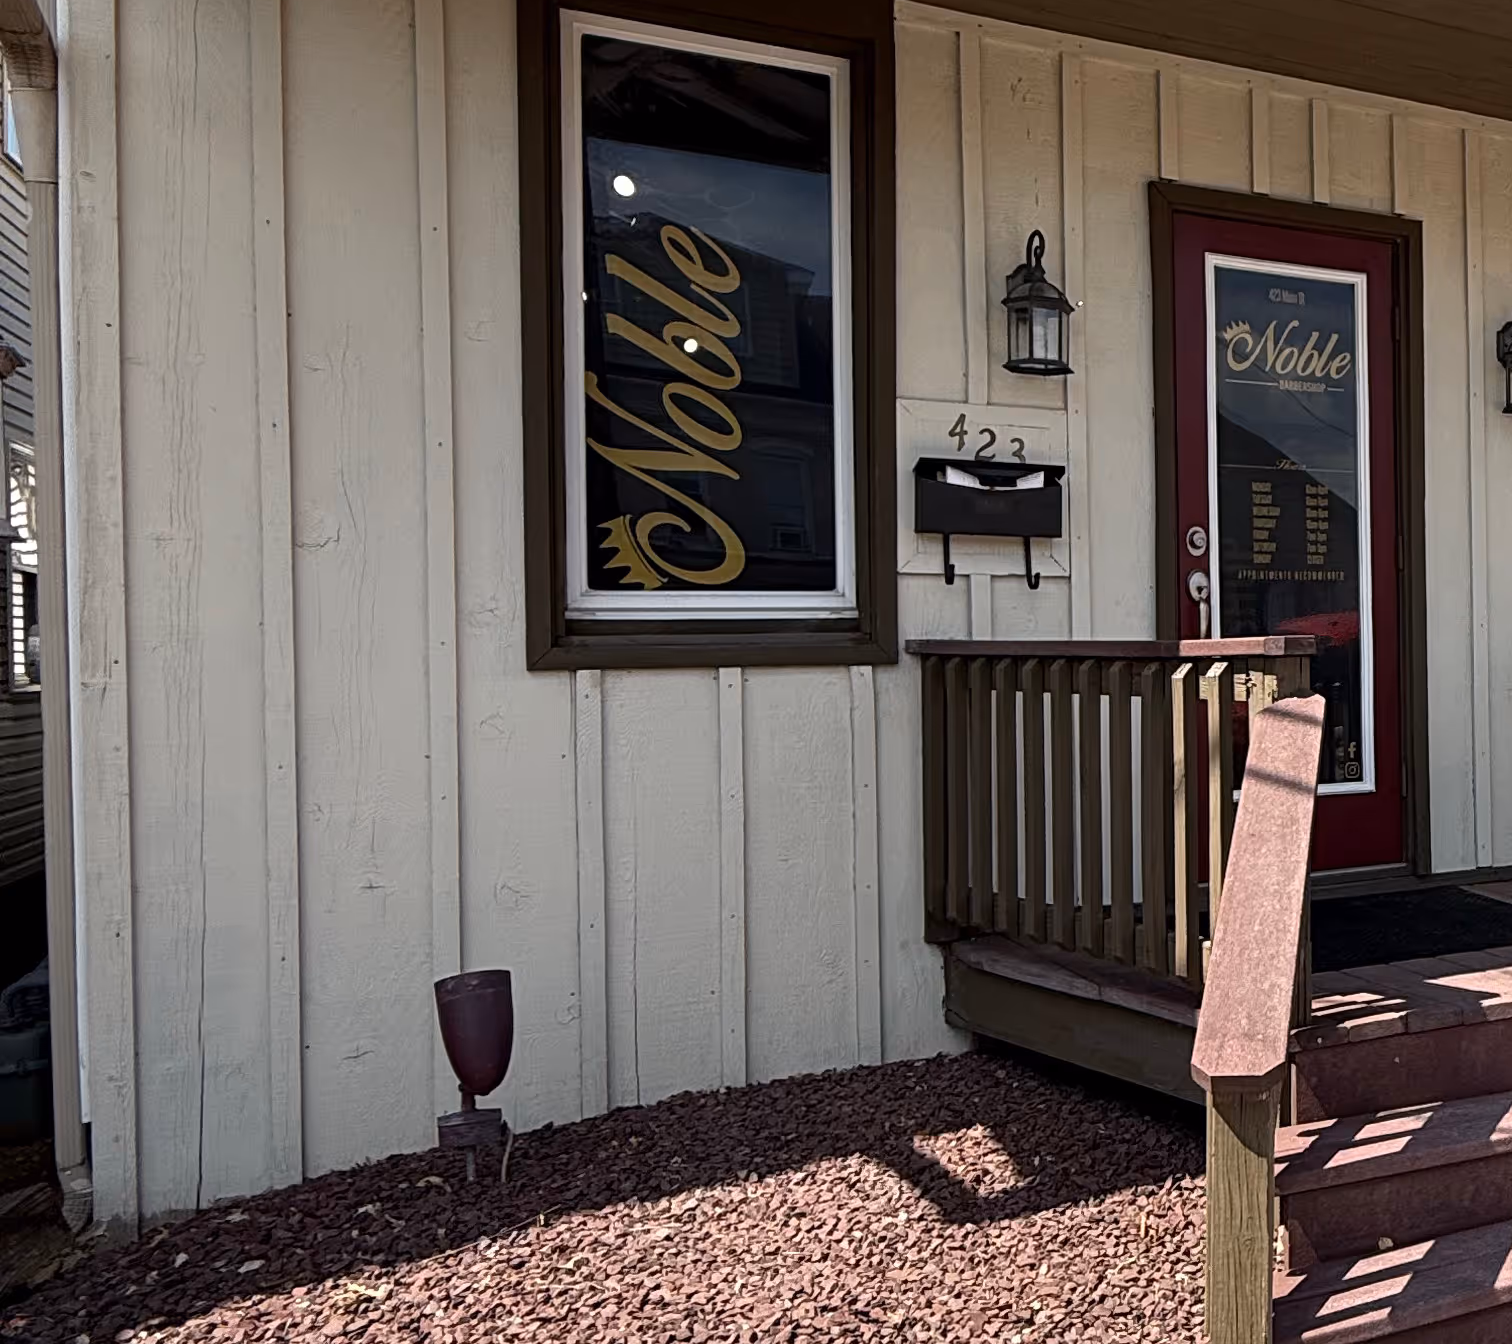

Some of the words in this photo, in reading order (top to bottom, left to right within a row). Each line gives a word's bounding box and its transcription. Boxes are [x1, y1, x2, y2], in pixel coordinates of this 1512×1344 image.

[1226, 320, 1351, 380] Noble
[585, 224, 746, 585] Noble
[948, 412, 1027, 465] 423
